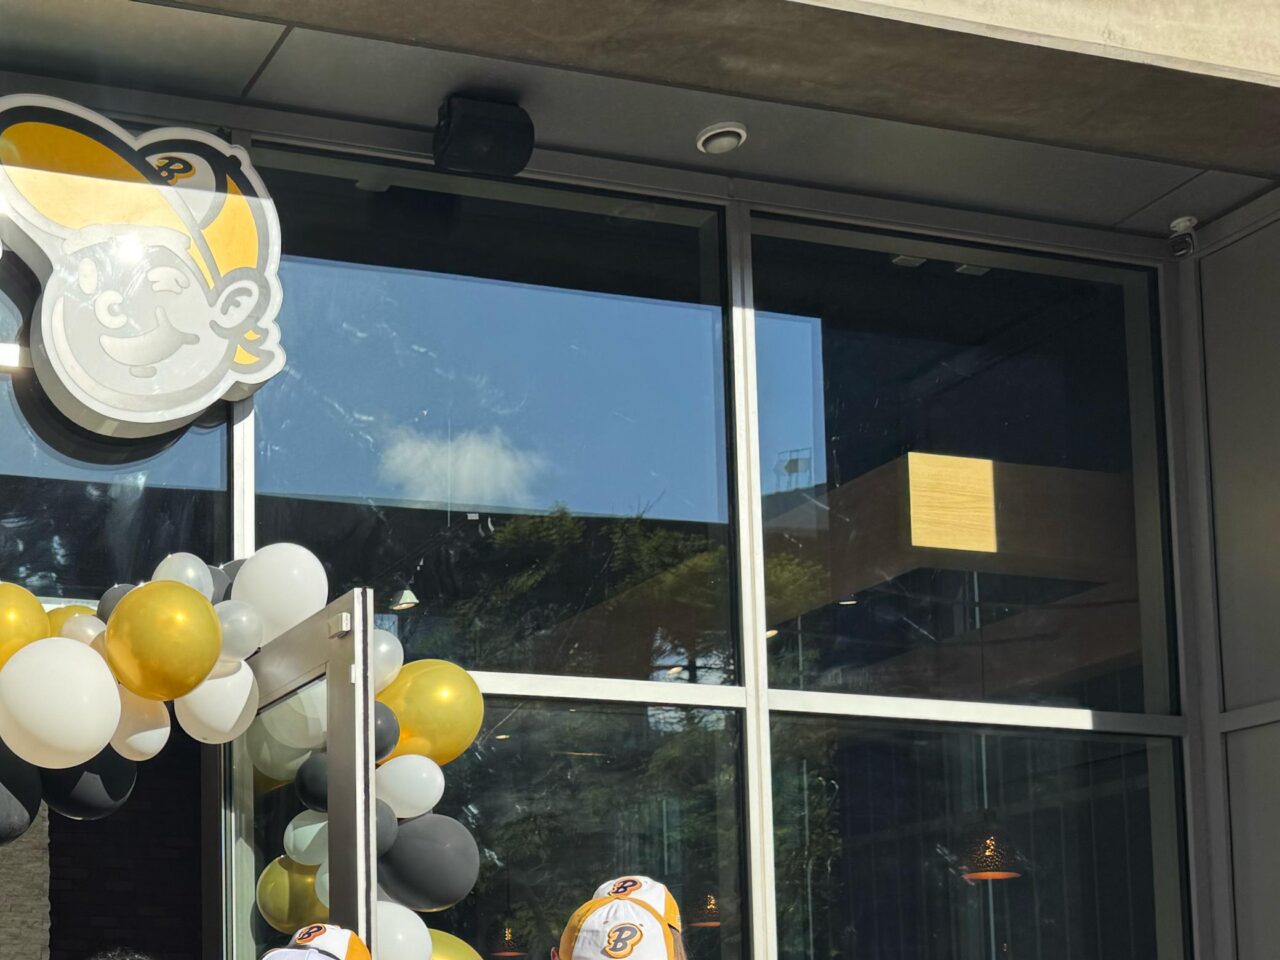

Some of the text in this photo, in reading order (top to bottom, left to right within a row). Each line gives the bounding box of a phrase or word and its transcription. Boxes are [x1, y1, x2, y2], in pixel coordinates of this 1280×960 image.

[609, 879, 640, 896] B
[296, 924, 324, 943] B
[606, 924, 640, 956] B
